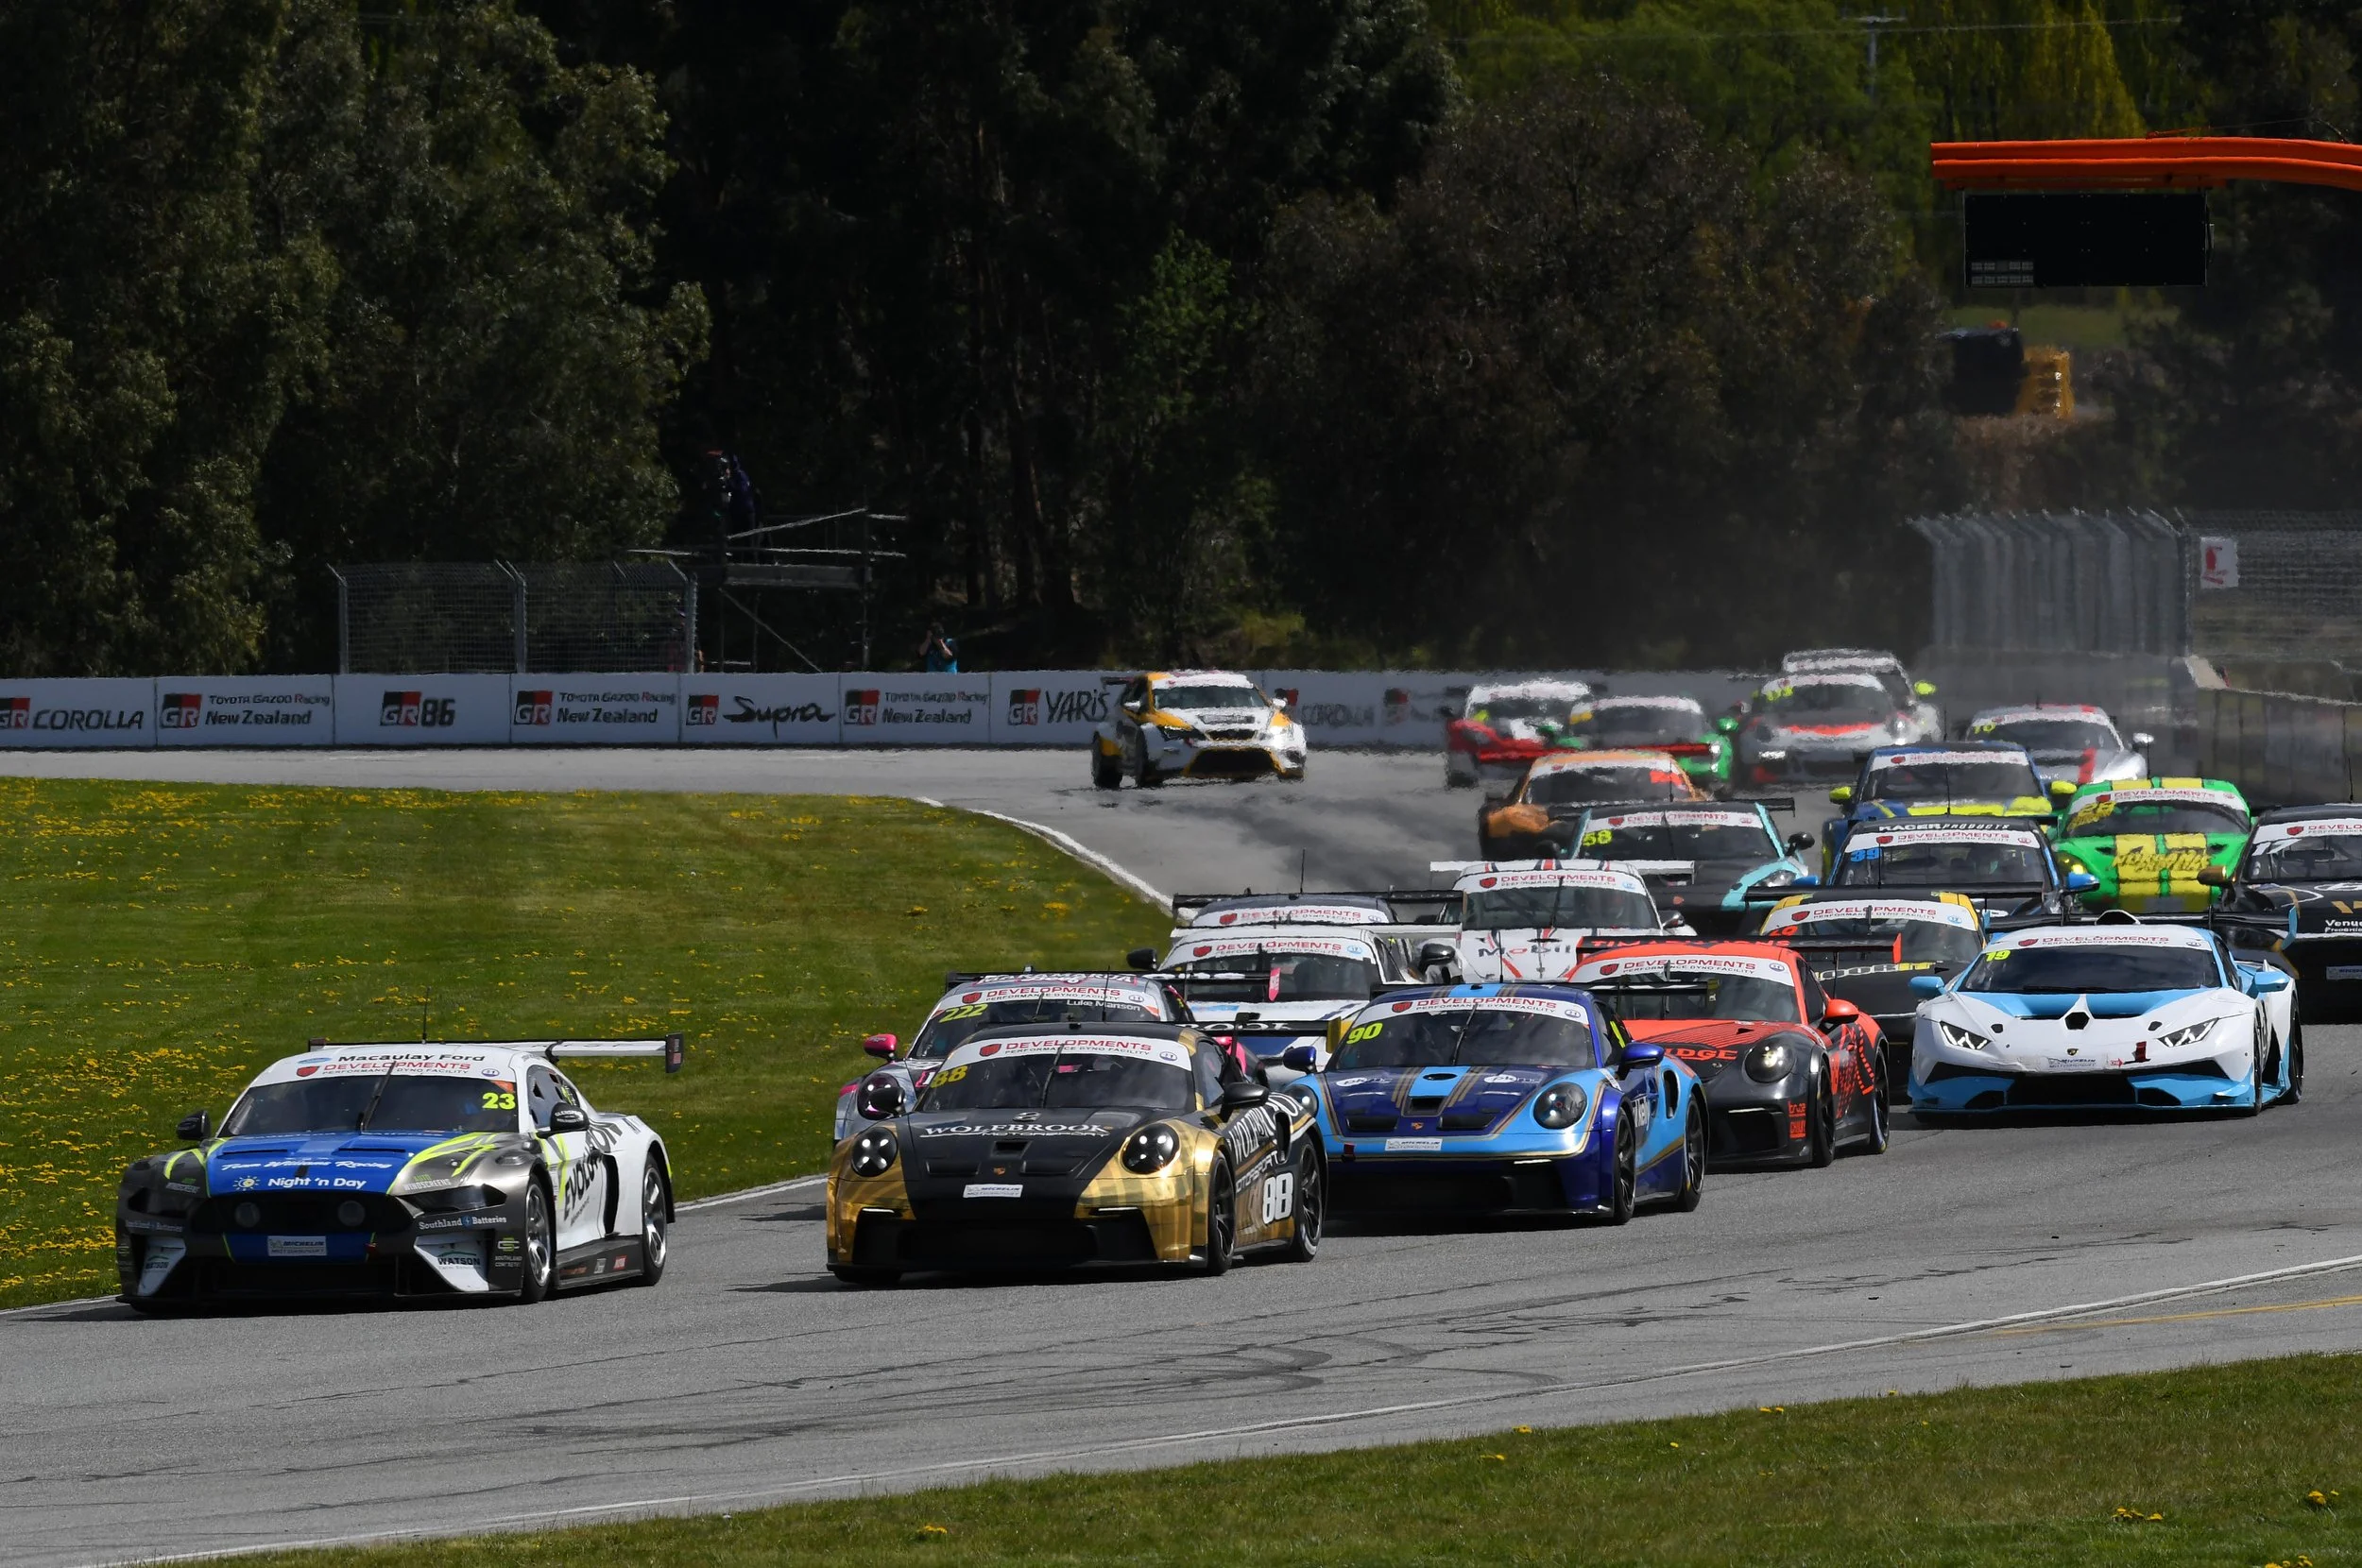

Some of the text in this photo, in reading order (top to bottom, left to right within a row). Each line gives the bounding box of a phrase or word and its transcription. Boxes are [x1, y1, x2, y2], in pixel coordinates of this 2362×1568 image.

[210, 694, 249, 704] TOYOTA
[294, 694, 330, 707] Racing
[161, 707, 199, 728] GR
[205, 710, 313, 724] New Zealand
[381, 698, 455, 726] GR 86
[556, 707, 658, 723] New Zealand
[686, 695, 835, 739] GR Supra
[882, 708, 972, 724] New Zealand
[33, 709, 144, 731] COROLLA
[1879, 823, 1941, 831] RACER
[1851, 847, 1882, 862] 39
[1986, 950, 2011, 963] 19
[986, 987, 1121, 997] DEVELOPMENTS
[1096, 1000, 1140, 1011] Manson
[1417, 997, 1557, 1009] DEVELOPMENTS
[1513, 1004, 1555, 1014] FACILITY
[938, 1003, 988, 1023] 222
[1346, 1022, 1383, 1045] 90
[1005, 1040, 1152, 1051] DEVELOPMENTS
[1107, 1047, 1150, 1055] FACILITY
[338, 1053, 485, 1062] Macaulay Ford
[324, 1062, 471, 1071] DEVELOPMENTS
[932, 1065, 968, 1087] 88
[483, 1093, 516, 1109] 23
[925, 1124, 1109, 1135] WOLFBROOK
[221, 1163, 262, 1171] Team
[334, 1161, 393, 1169] Racing
[268, 1177, 311, 1188] Night
[334, 1178, 367, 1189] Day
[403, 1178, 453, 1191] WINDSCREENS
[1262, 1172, 1294, 1225] 88
[419, 1215, 507, 1230] Southland Batteries
[437, 1257, 481, 1266] WATSON
